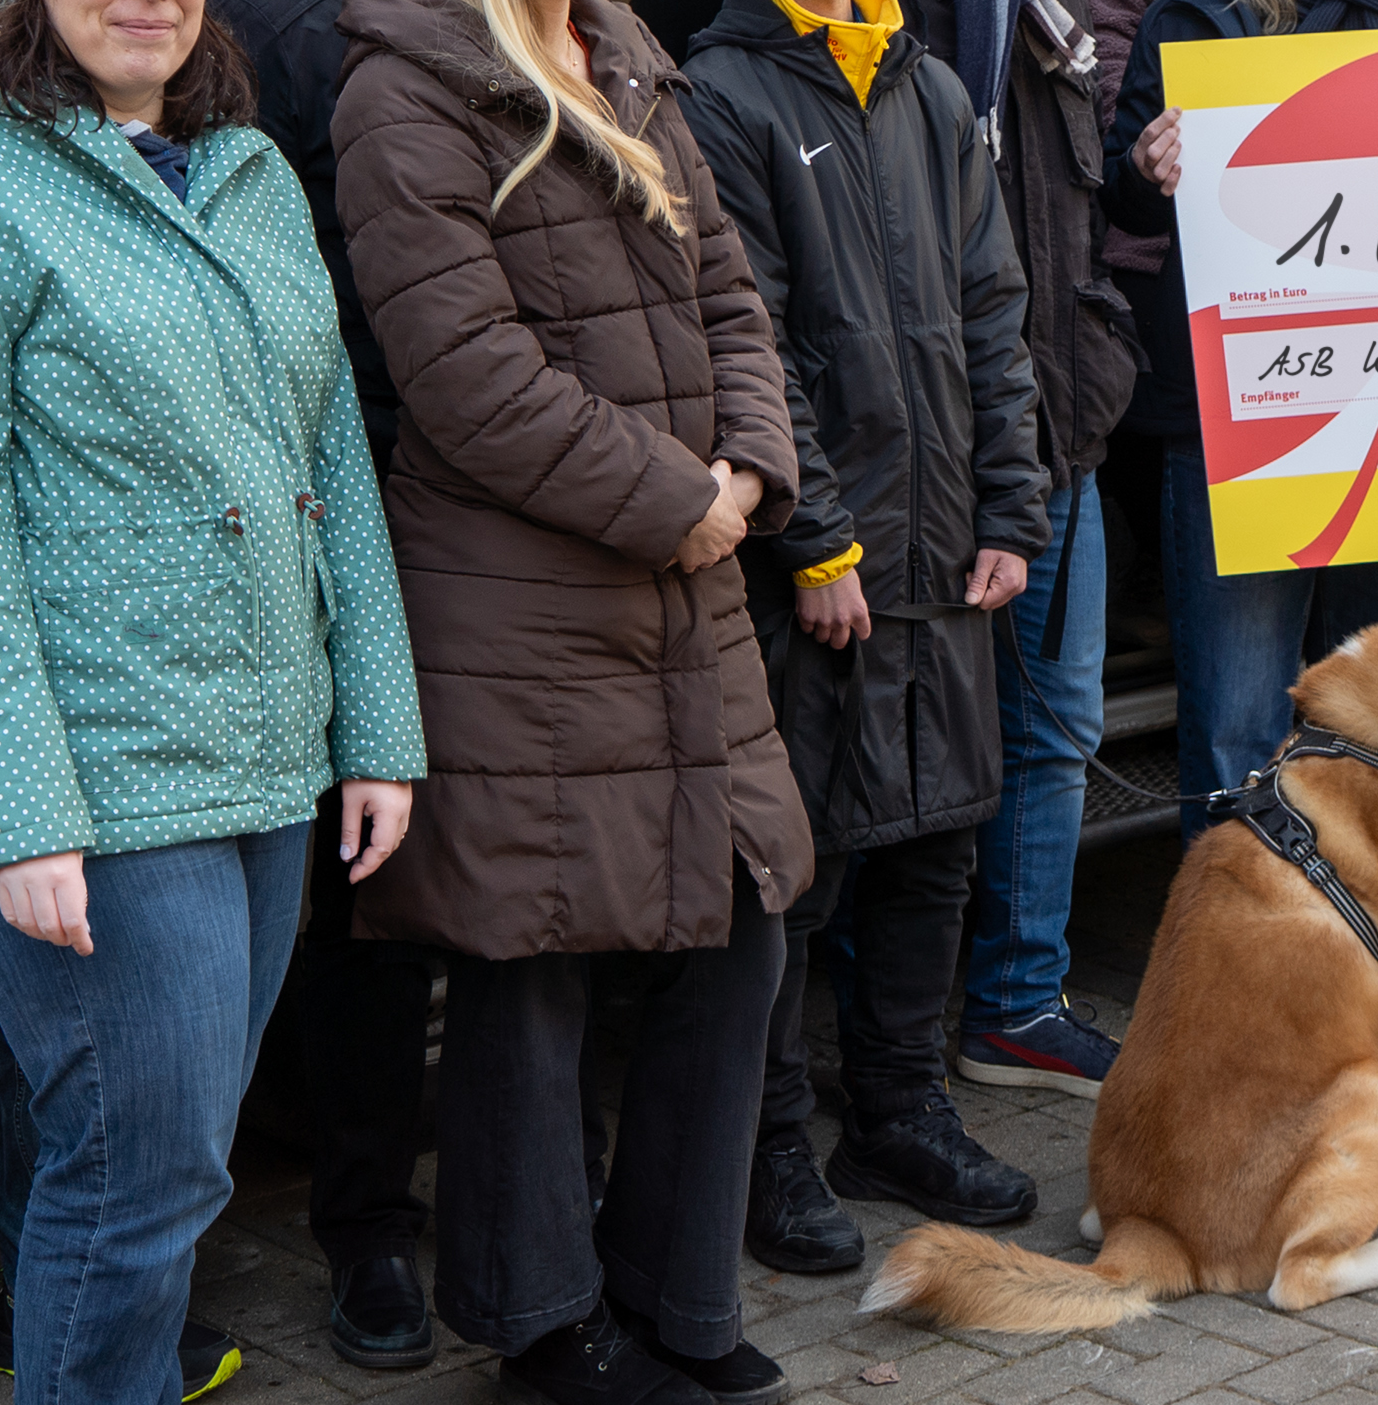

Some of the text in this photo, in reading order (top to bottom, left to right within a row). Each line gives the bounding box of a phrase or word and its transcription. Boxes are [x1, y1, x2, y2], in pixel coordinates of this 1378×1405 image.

[1229, 286, 1308, 303] Betrag in Euro
[1258, 345, 1334, 381] ASB
[1240, 388, 1301, 405] Empfänger
